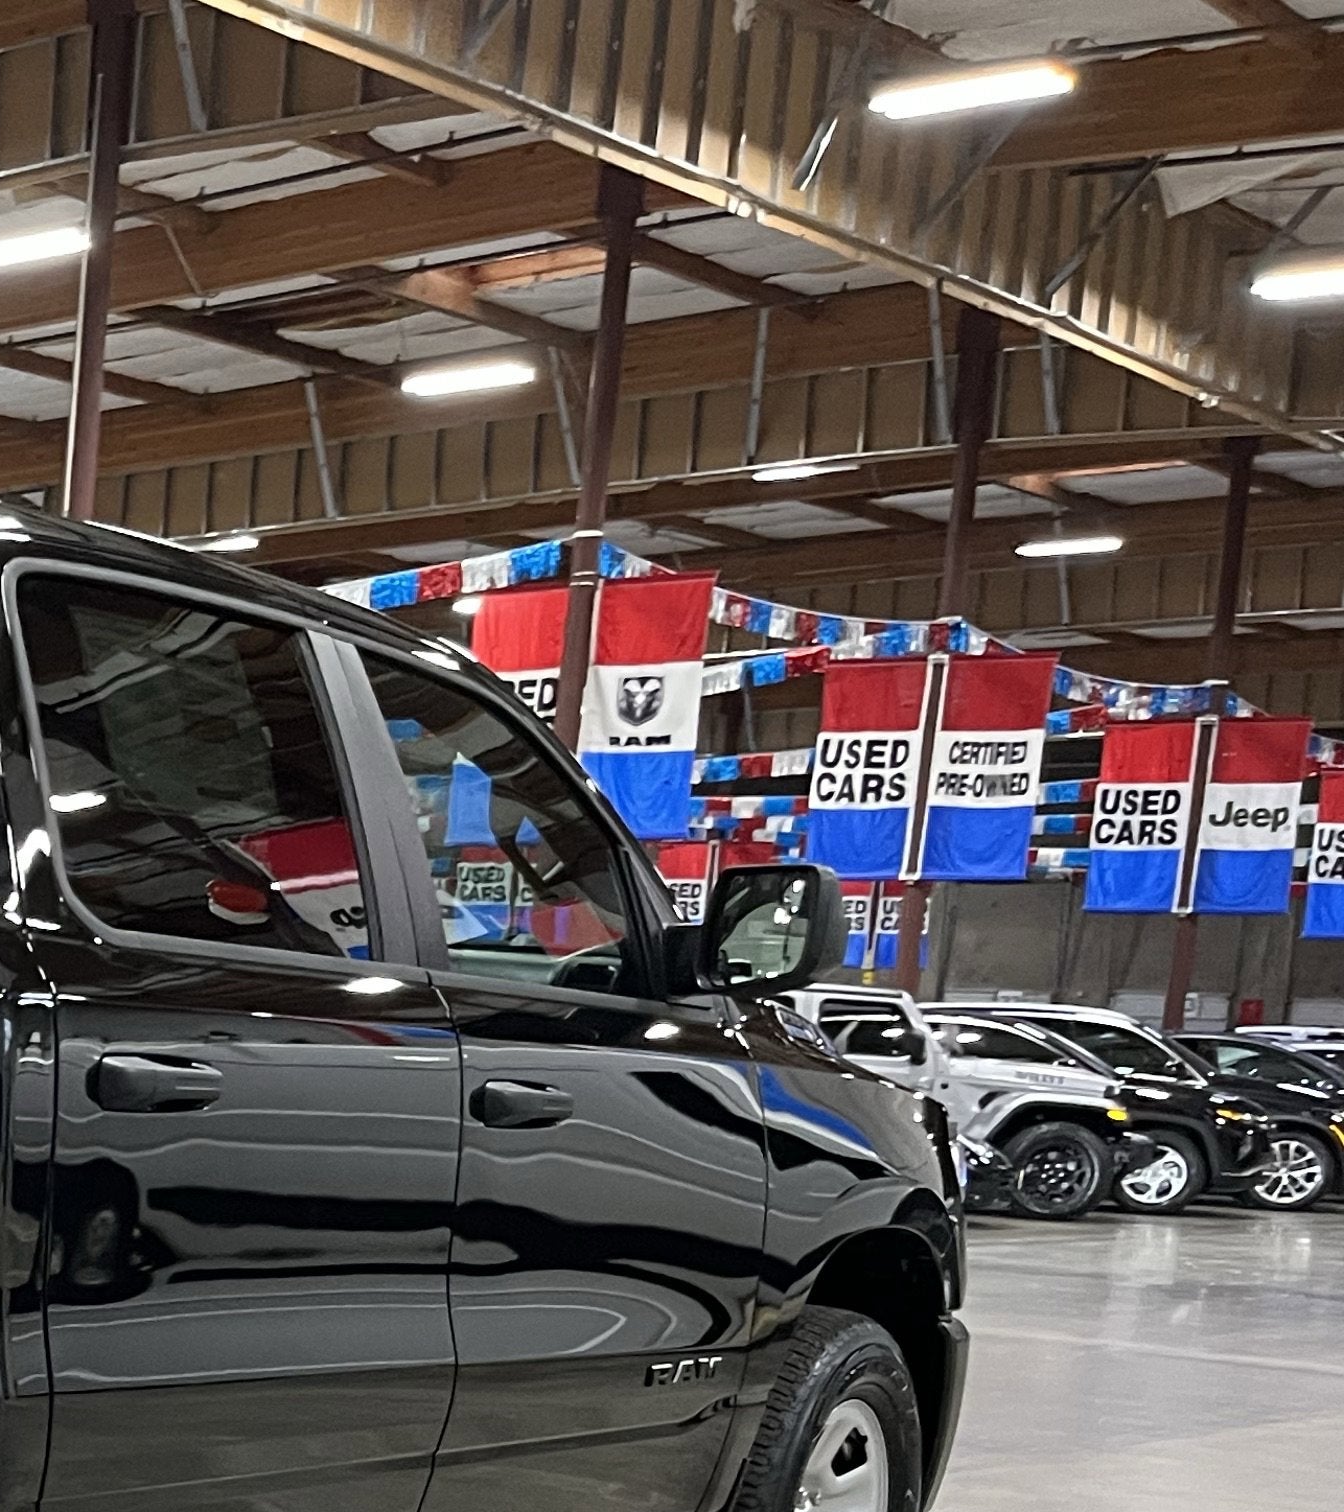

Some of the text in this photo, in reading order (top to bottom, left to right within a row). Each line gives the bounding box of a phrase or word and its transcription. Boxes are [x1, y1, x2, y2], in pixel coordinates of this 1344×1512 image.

[503, 678, 560, 712] ED
[609, 735, 671, 746] RAM
[948, 741, 1028, 765] CERTIFIED
[820, 739, 910, 769] USED
[816, 772, 906, 804] CARS
[1100, 789, 1181, 815] USED
[1208, 801, 1289, 832] Jeep
[1095, 819, 1178, 845] CARS
[460, 866, 506, 883] USED
[460, 885, 507, 902] CARS
[645, 1356, 723, 1387] RAM
